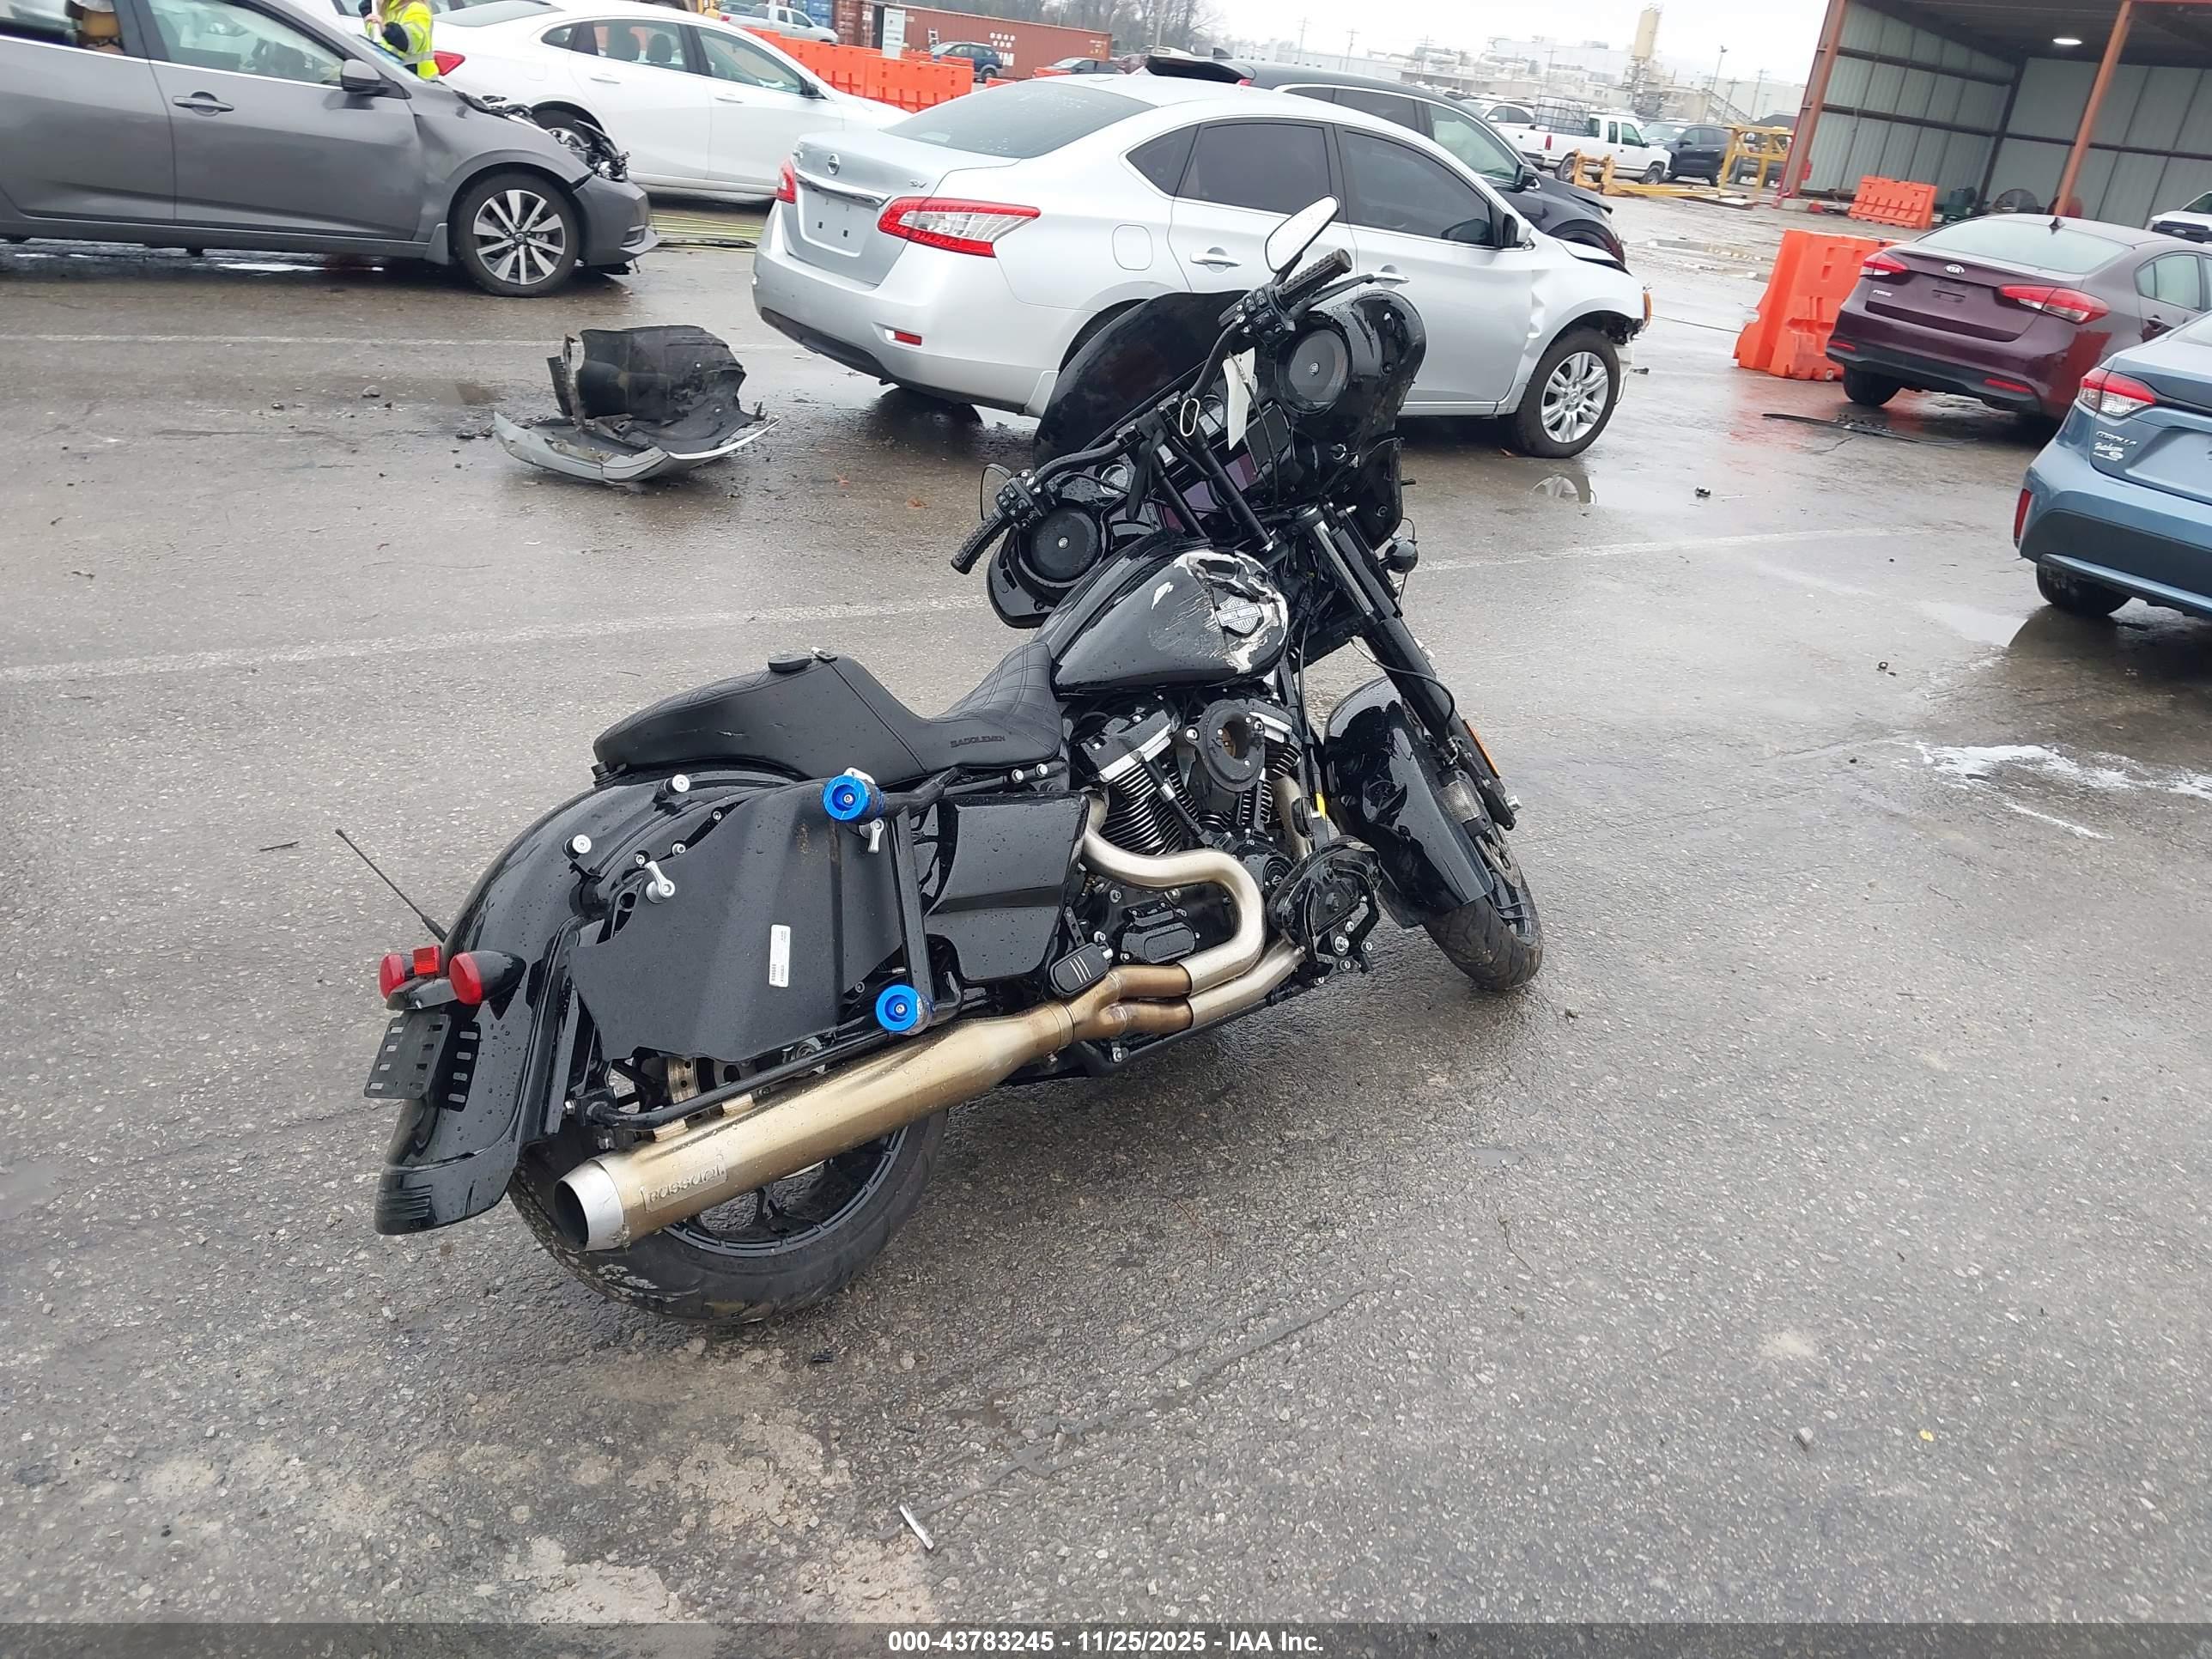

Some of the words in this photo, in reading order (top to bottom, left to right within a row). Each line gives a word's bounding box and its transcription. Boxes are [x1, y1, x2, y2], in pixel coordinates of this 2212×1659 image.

[909, 179, 927, 189] SV
[1944, 264, 1965, 275] KIA
[2095, 430, 2137, 446] COROLLA
